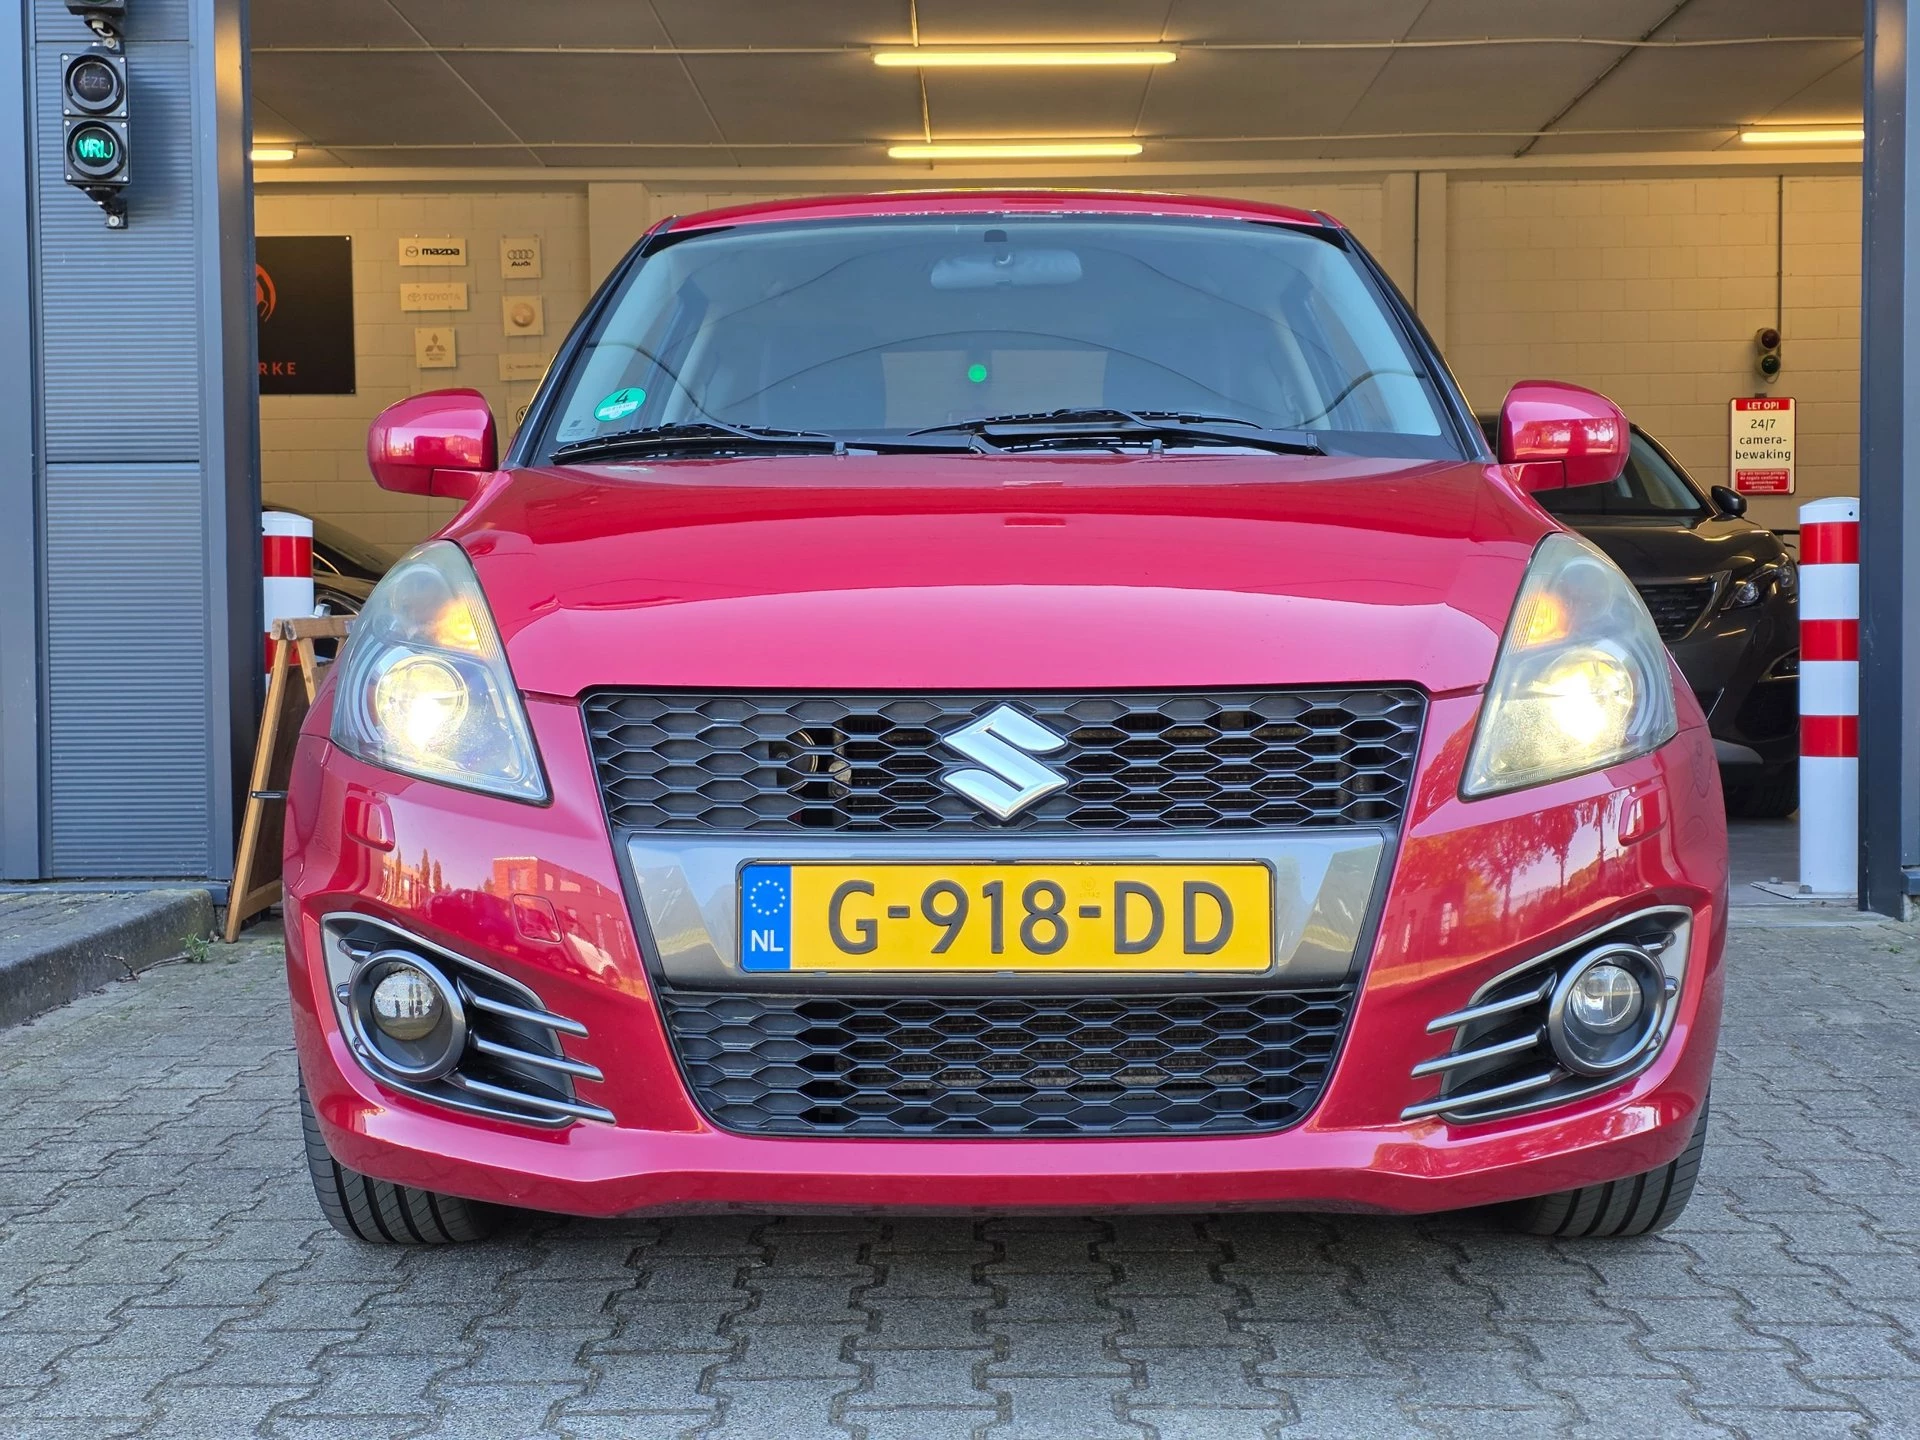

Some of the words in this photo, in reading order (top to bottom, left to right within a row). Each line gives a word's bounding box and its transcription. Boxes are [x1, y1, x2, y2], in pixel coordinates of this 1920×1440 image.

[78, 138, 114, 158] VRIJ
[422, 248, 460, 256] mazda
[422, 292, 461, 301] TOYOTA
[615, 389, 629, 403] 4
[1750, 419, 1776, 431] 24/7
[1739, 437, 1787, 445] camera-
[1735, 449, 1791, 461] bewaking
[828, 879, 1234, 955] G-918-DD
[750, 929, 784, 952] NL
